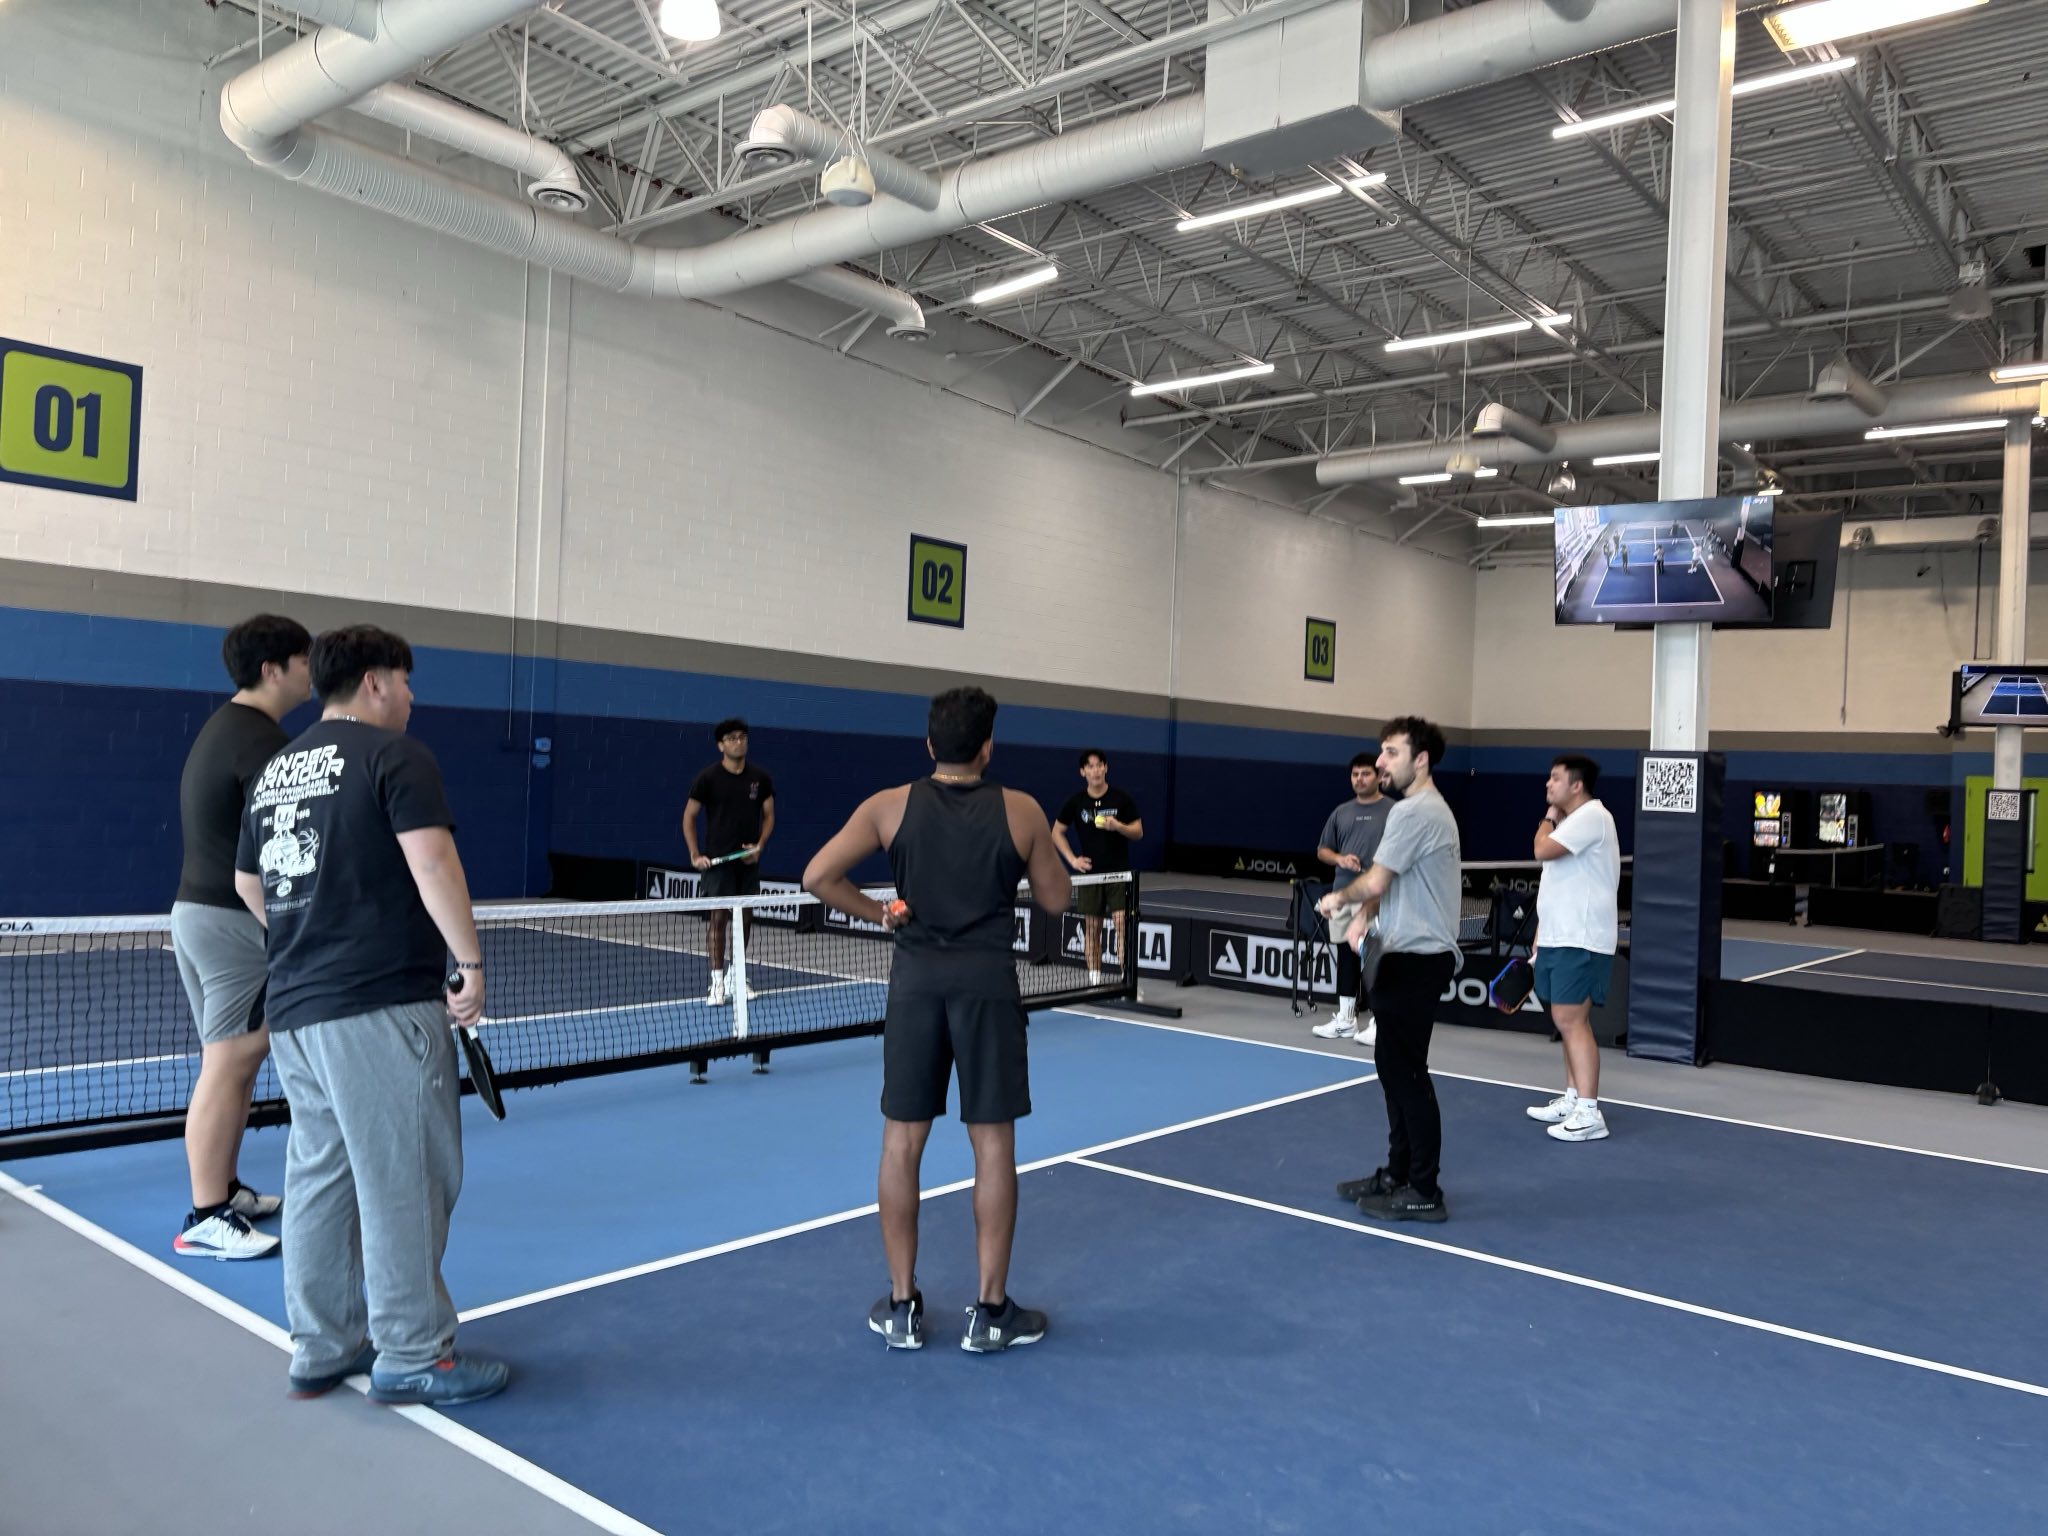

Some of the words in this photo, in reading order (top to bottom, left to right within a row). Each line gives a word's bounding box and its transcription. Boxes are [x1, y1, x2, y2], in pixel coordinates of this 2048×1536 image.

[33, 384, 102, 459] 01
[922, 560, 953, 604] 02
[1312, 634, 1329, 666] 03
[254, 758, 345, 797] ARMOUR
[264, 745, 338, 777] UNDER
[1247, 859, 1297, 875] JOOLA
[1252, 945, 1333, 984] JOOLA
